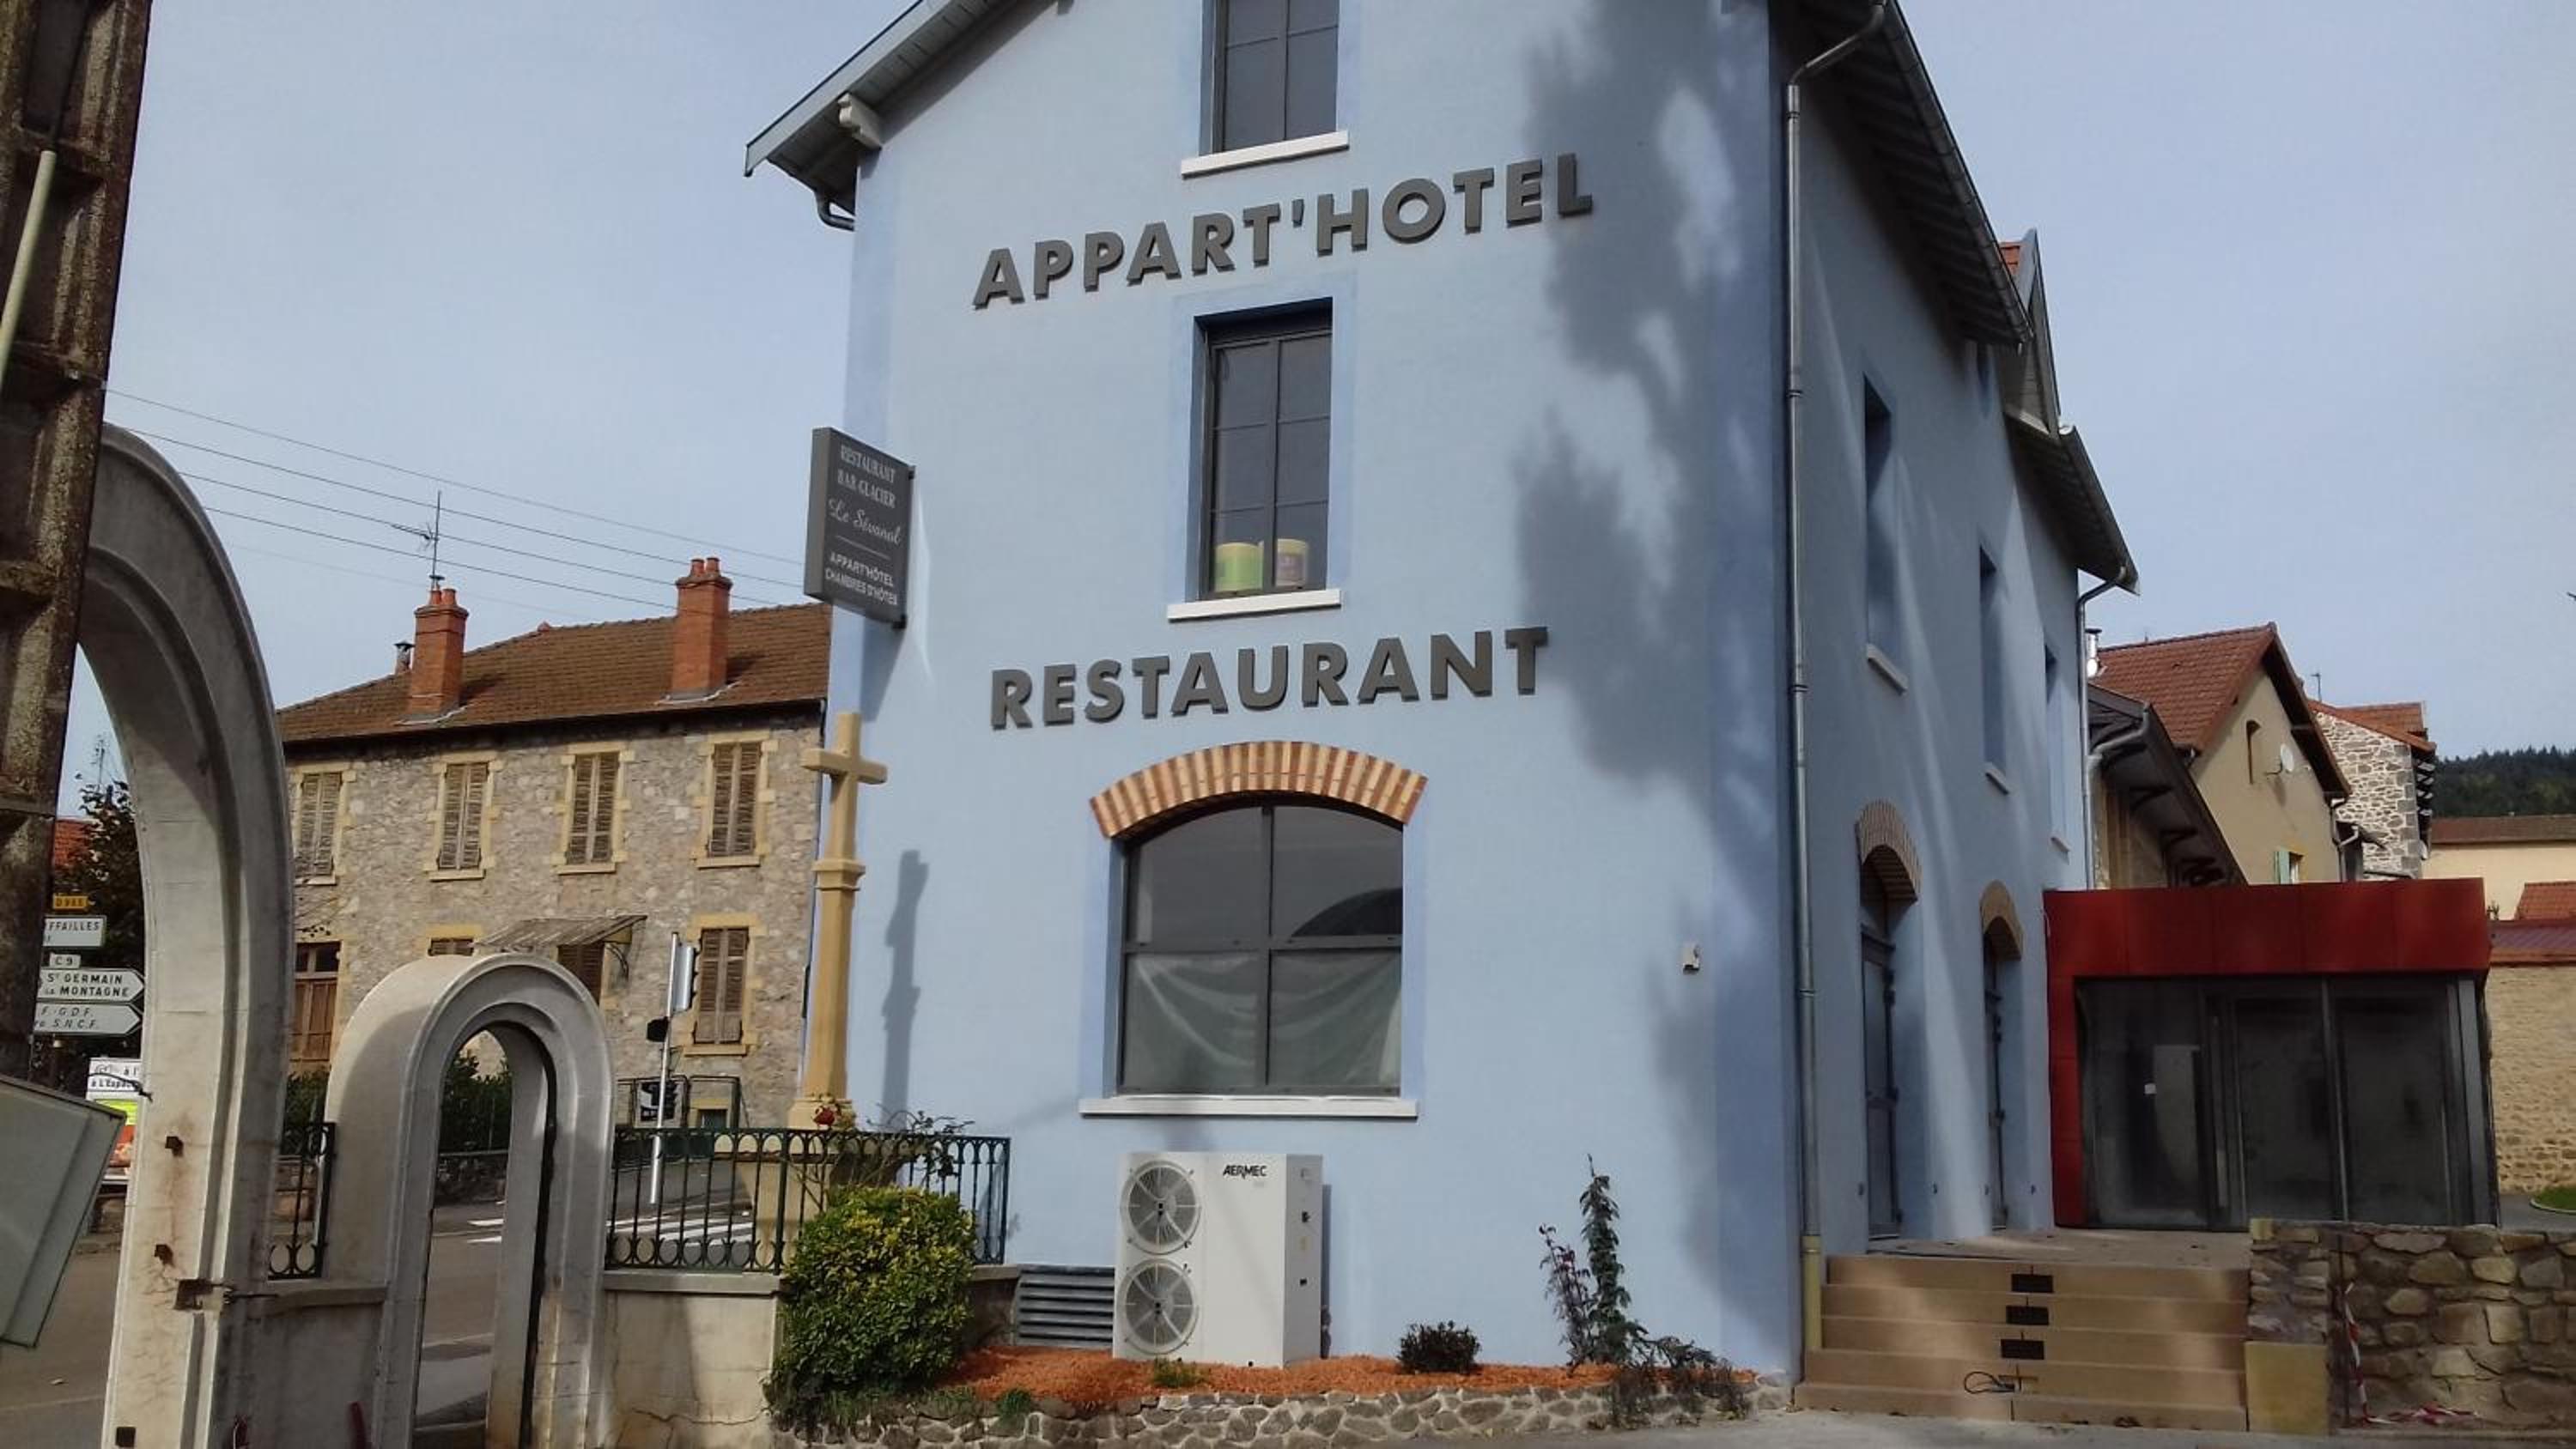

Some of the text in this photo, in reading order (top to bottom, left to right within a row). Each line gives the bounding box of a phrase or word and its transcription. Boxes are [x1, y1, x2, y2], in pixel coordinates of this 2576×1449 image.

[973, 153, 1593, 310] APPART'HOTEL
[840, 444, 896, 483] RESTAURANT
[837, 470, 896, 508] BAR GLACIER
[828, 496, 849, 524] Le
[991, 627, 1548, 730] RESTAURANT
[59, 985, 129, 997] MONTAGNE
[64, 973, 123, 985] GERMAIN
[1223, 1165, 1267, 1179] AERMEC
